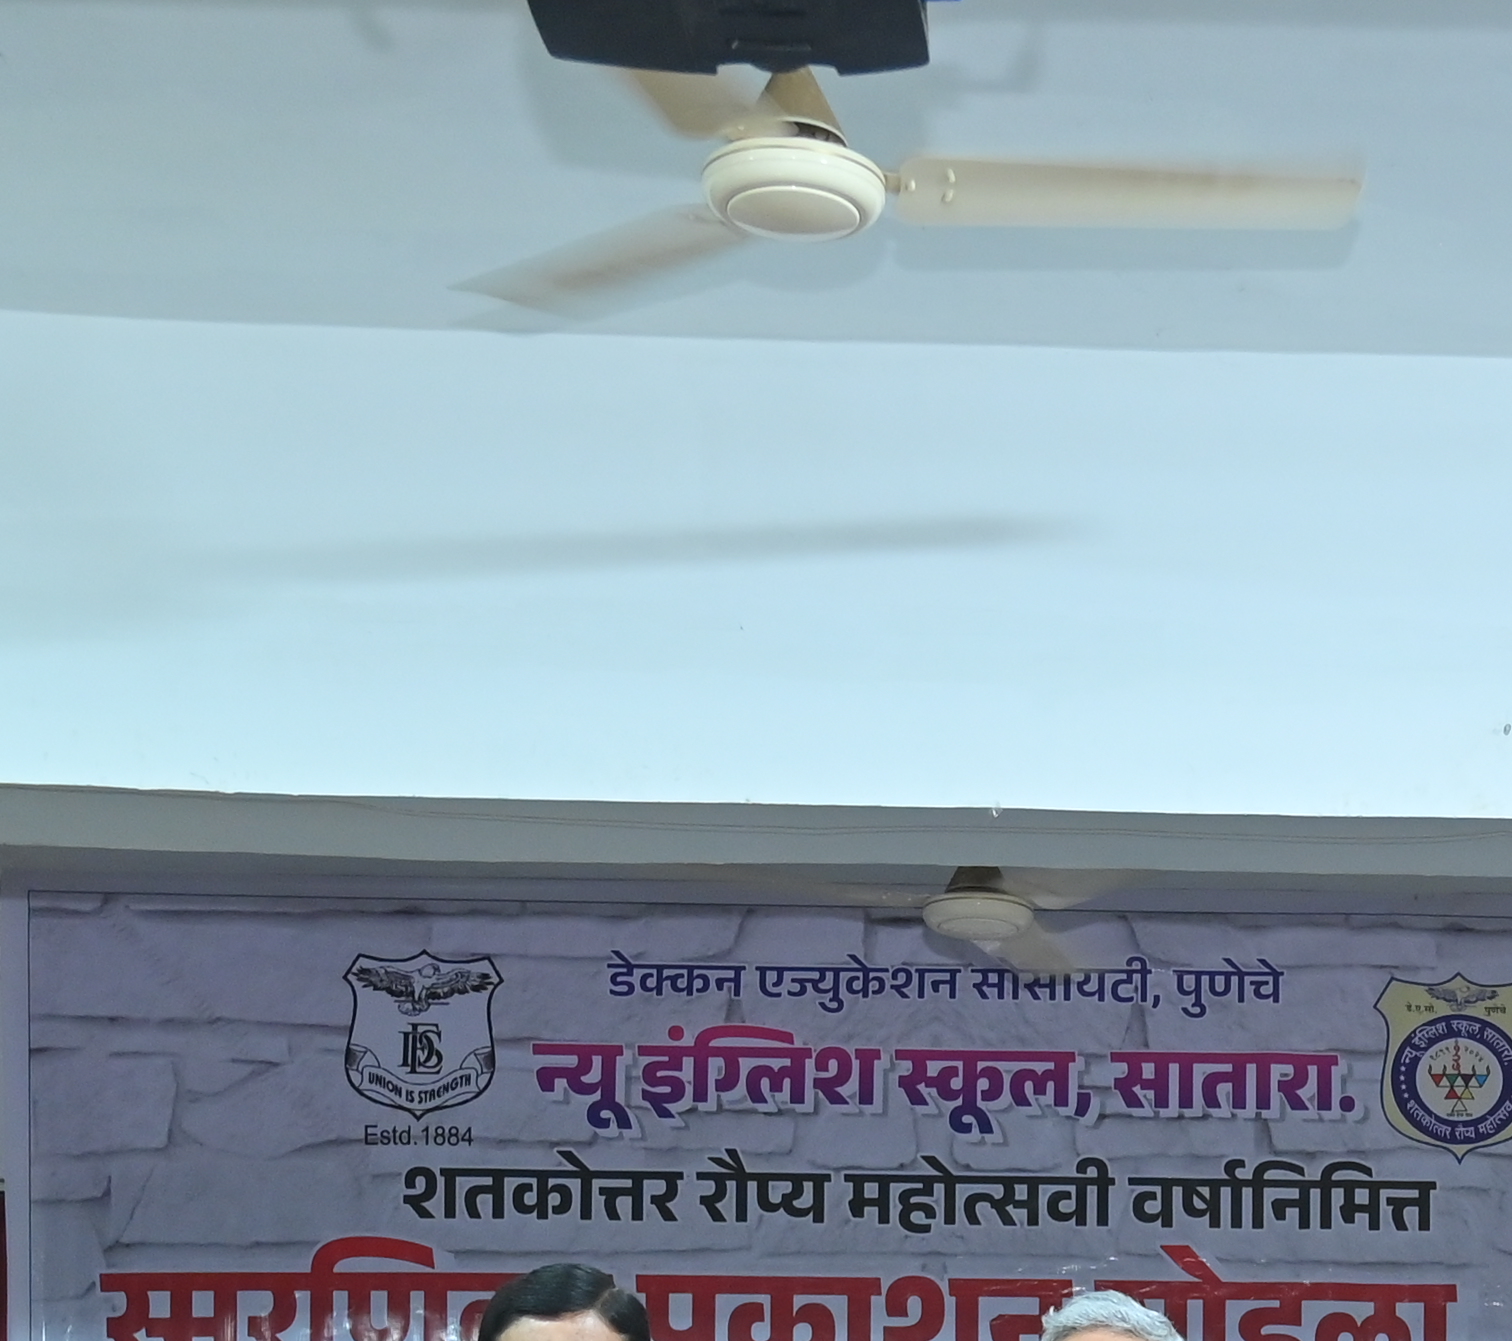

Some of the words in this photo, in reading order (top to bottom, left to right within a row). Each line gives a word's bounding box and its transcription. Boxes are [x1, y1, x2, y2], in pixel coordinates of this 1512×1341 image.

[607, 950, 746, 998] डेक्कन
[756, 954, 962, 1013] एज्युकेशन
[1174, 957, 1285, 1018] पुणेचे
[368, 1071, 402, 1099] UNION
[405, 1089, 415, 1104] IS
[531, 1042, 634, 1131] न्यू
[637, 1024, 882, 1120] इंग्लिश
[894, 1048, 1093, 1135] स्कूल,
[1109, 1051, 1358, 1114] सातारा.
[402, 1148, 684, 1222] शतकोत्तर
[696, 1148, 832, 1225] रौप्य
[843, 1155, 1116, 1235] महोत्सवी
[1128, 1158, 1438, 1232] वर्षानिमित्त
